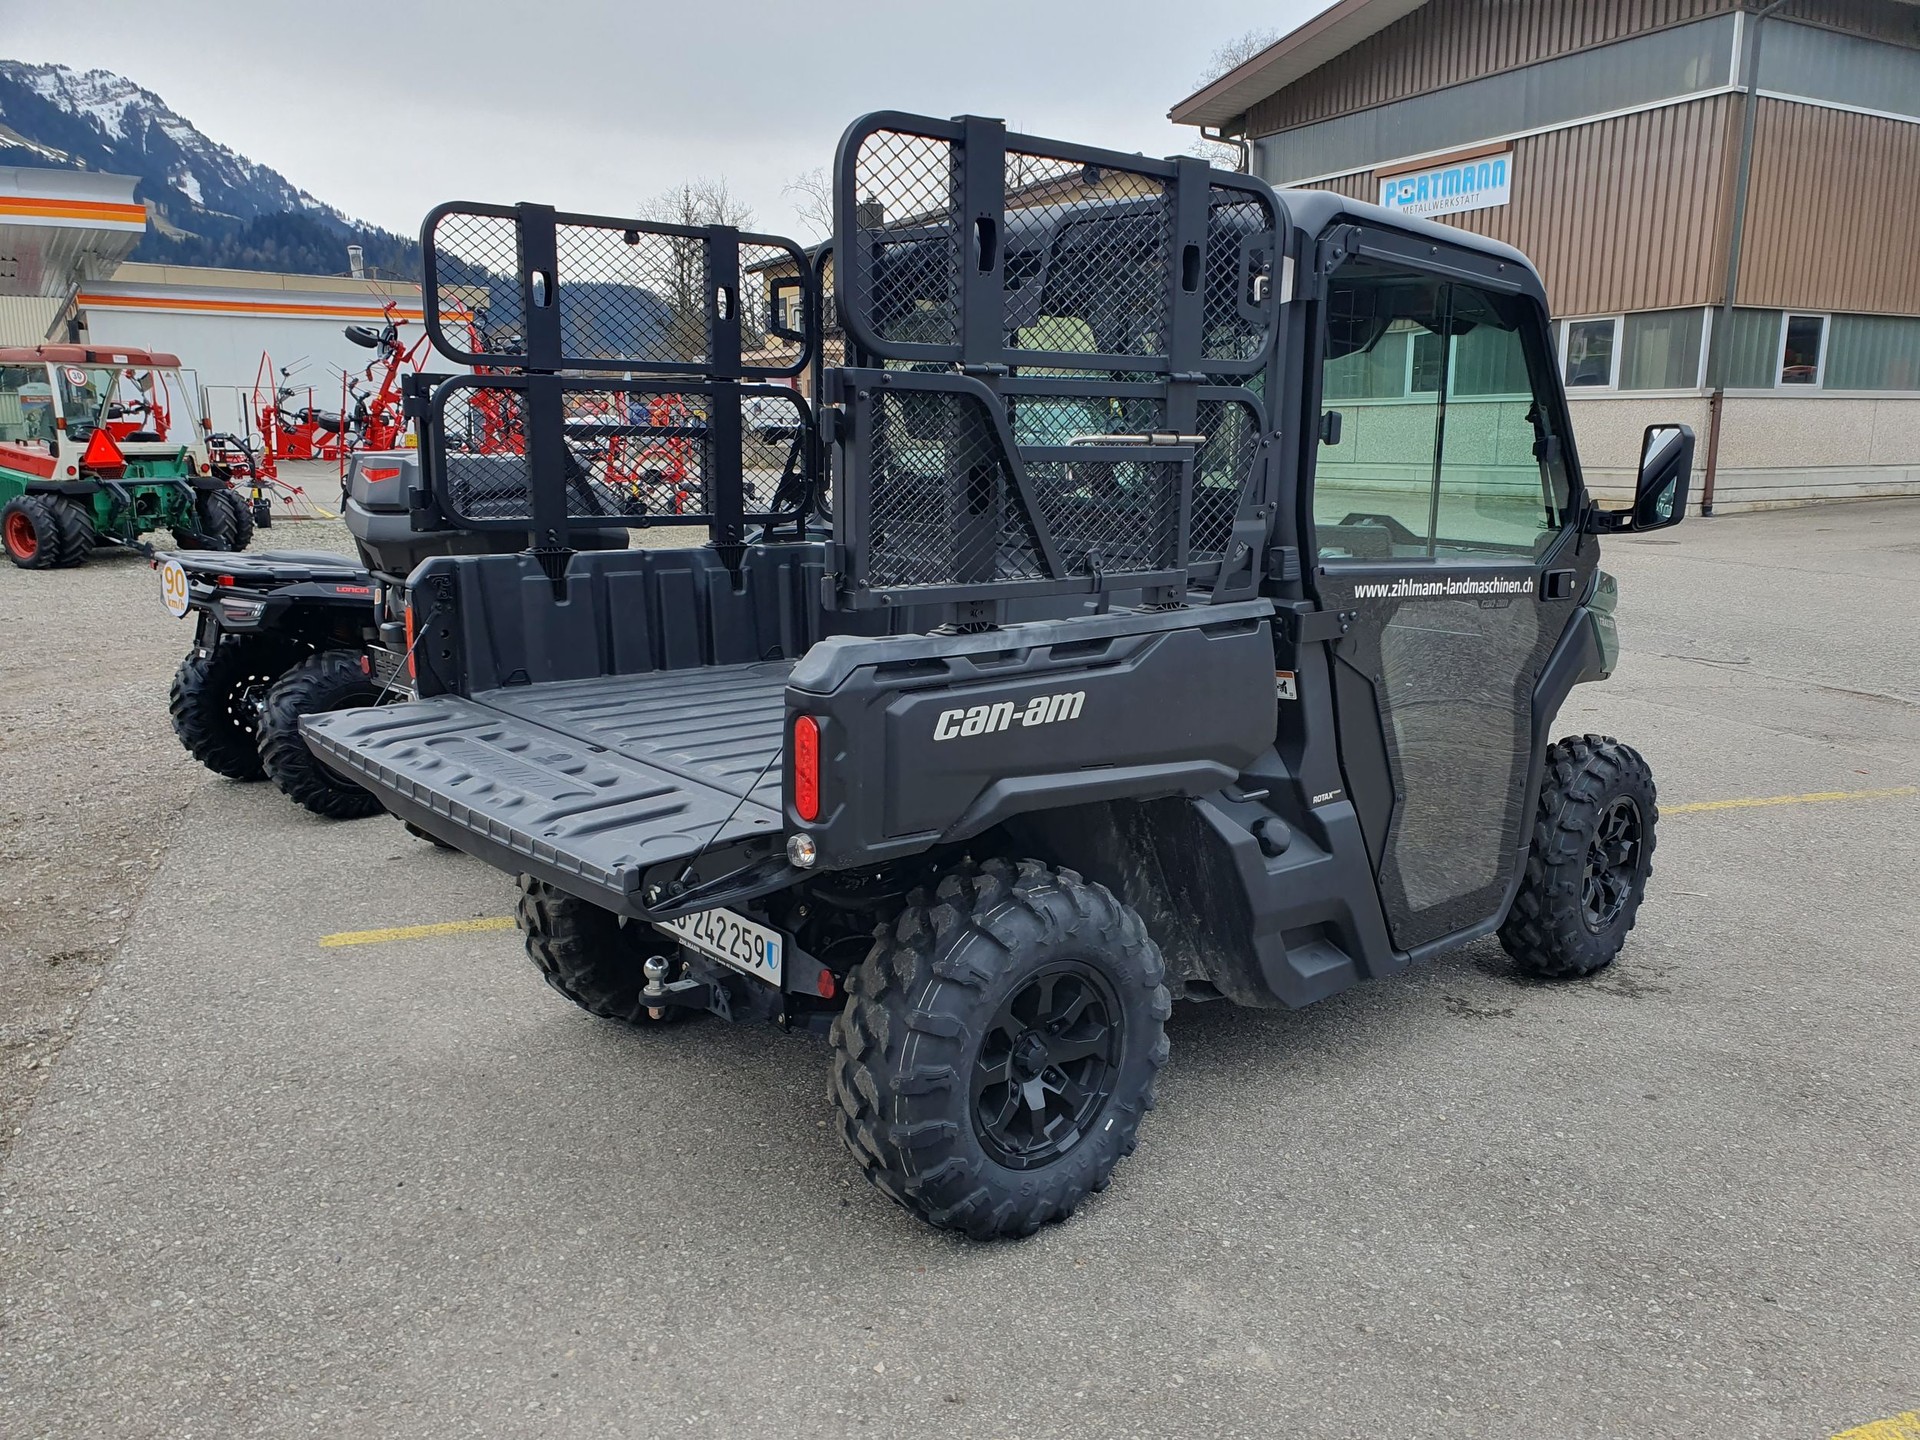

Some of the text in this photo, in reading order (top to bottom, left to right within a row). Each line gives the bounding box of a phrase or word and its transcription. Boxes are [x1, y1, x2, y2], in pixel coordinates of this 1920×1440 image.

[1385, 159, 1506, 208] PORTMANN
[1402, 192, 1480, 215] METALLWERKSTATT
[71, 371, 82, 380] 30
[165, 566, 185, 597] 90
[1354, 577, 1534, 598] www.zihlmann-landmaschinen.ch
[168, 596, 185, 610] km/h
[1312, 789, 1341, 804] ROTAX
